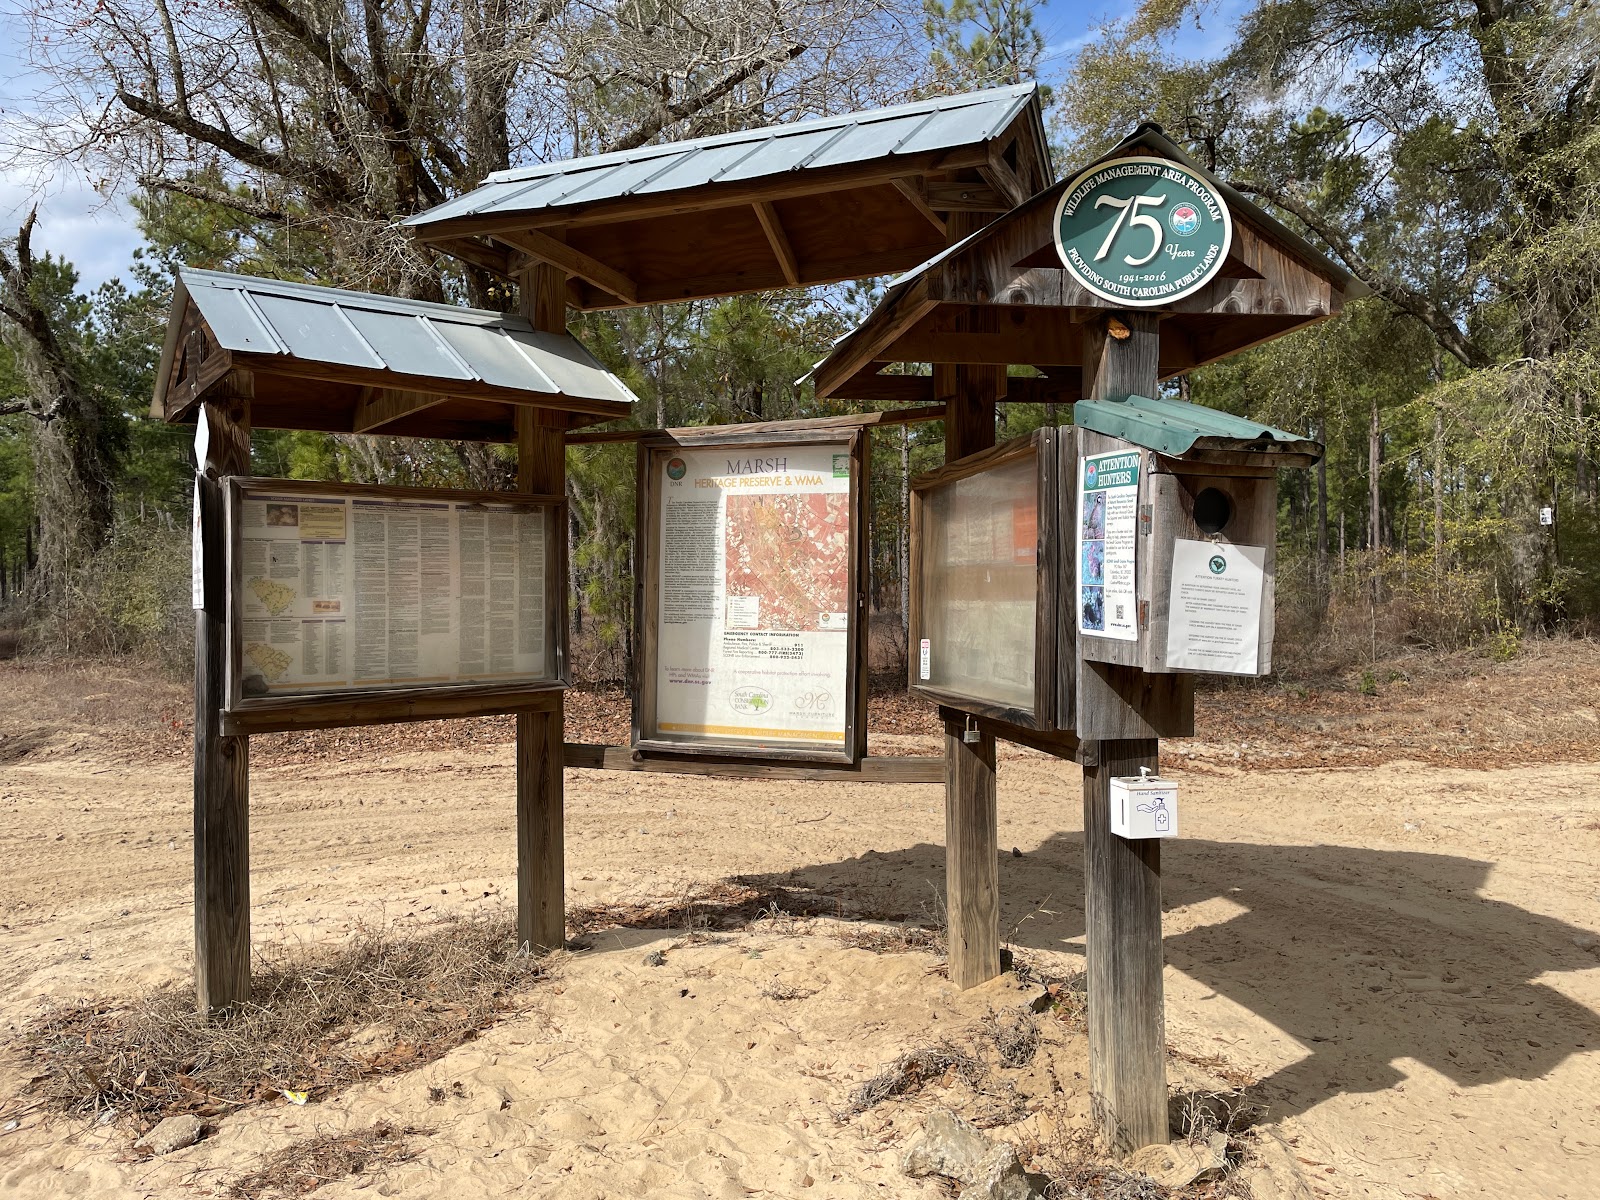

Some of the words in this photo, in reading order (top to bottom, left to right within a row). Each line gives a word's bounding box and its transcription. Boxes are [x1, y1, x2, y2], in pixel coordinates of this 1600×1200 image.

[1063, 178, 1097, 217] WILDLIFE
[1094, 165, 1162, 186] MANAGEMENT
[1161, 169, 1187, 186] AREA
[1184, 178, 1222, 222] PROGRAM
[1093, 193, 1167, 266] 75
[1164, 243, 1195, 260] Years
[1067, 246, 1104, 285] PROVIDING
[1102, 279, 1132, 297] SOUTH
[1131, 281, 1175, 298] CAROLINA
[1174, 266, 1204, 290] PUBLIC
[1199, 243, 1220, 273] LANDS
[1118, 270, 1167, 283] 1941-2016
[726, 457, 788, 475] MARSH
[1098, 454, 1139, 472] ATTENTION
[694, 476, 737, 489] HERITAGE
[739, 475, 782, 488] PRESERVE
[784, 475, 793, 486] &
[794, 475, 823, 486] WMA
[1098, 470, 1132, 486] HUNTERS
